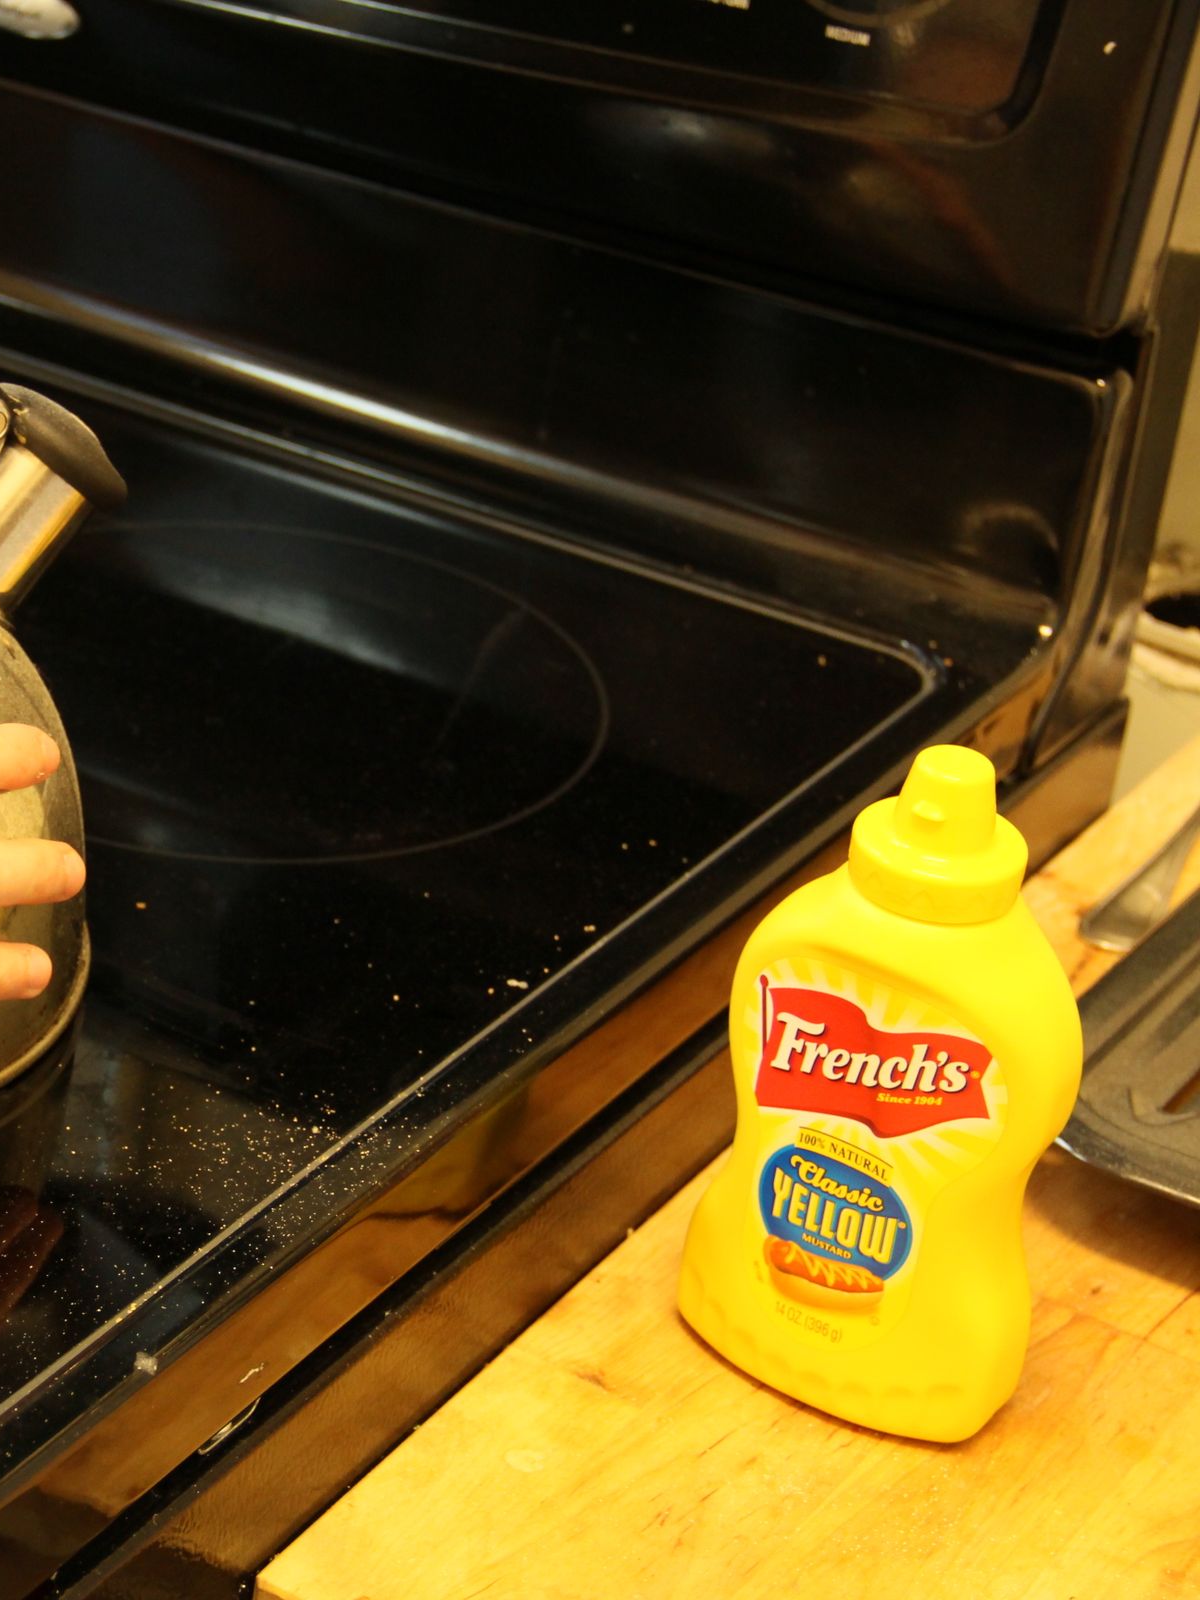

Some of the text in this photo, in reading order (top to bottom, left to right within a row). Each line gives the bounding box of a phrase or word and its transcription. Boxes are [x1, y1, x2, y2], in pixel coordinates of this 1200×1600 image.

[770, 1011, 970, 1093] French's
[876, 1092, 943, 1106] Since 1904
[790, 1154, 884, 1212] Classic
[828, 1142, 888, 1182] NATURAL
[772, 1166, 898, 1265] YELLOW
[802, 1232, 852, 1260] MUSTARD
